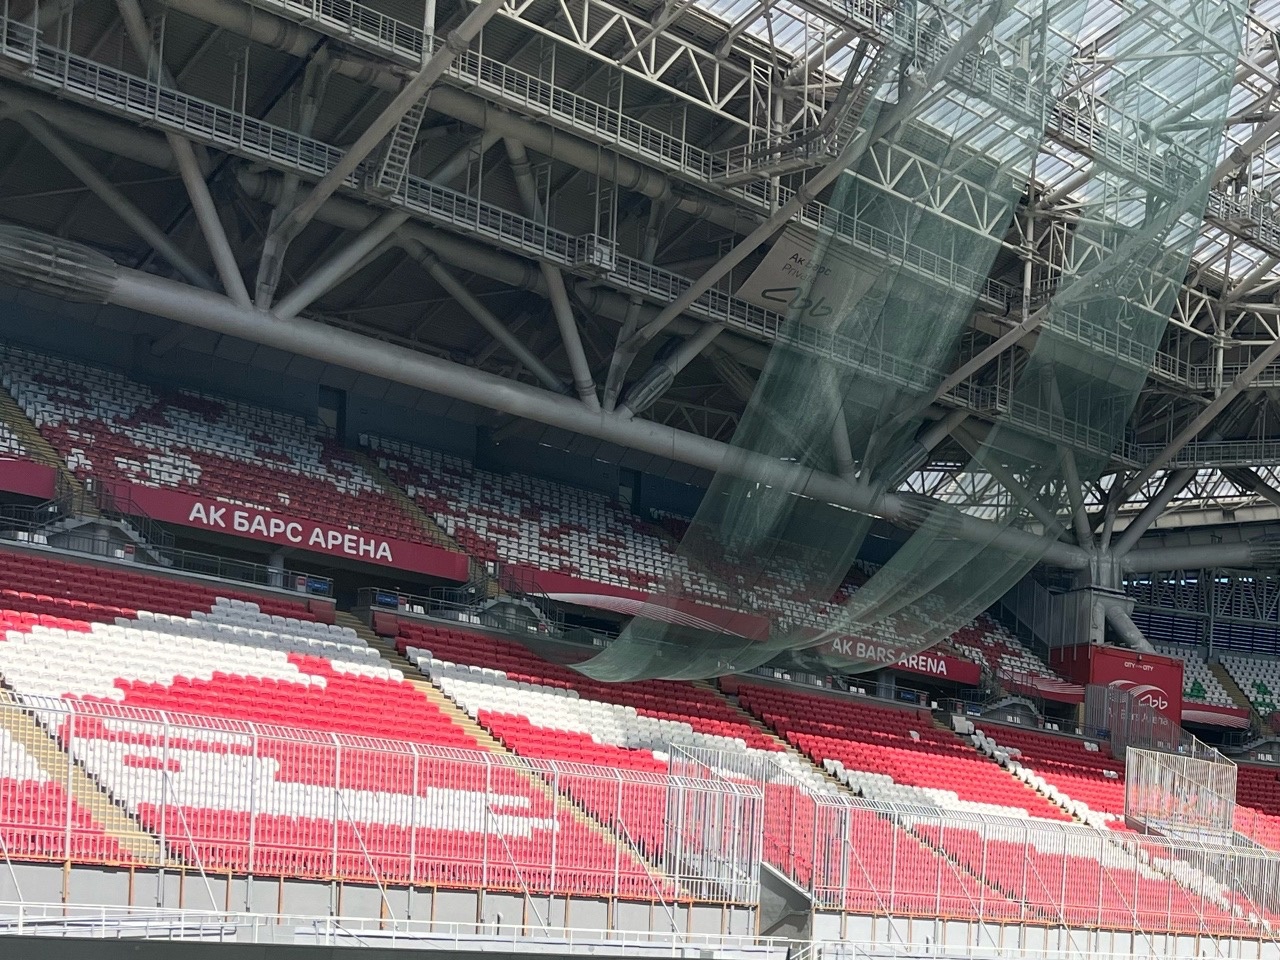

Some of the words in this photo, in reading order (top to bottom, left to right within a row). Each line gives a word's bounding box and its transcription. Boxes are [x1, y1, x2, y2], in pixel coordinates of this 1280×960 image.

[789, 252, 805, 266] Ак
[188, 502, 227, 528] АК
[233, 510, 303, 543] БАРС
[308, 527, 393, 562] АРЕНА
[831, 638, 853, 656] AK
[856, 642, 896, 663] BARS
[898, 652, 948, 675] ARENA
